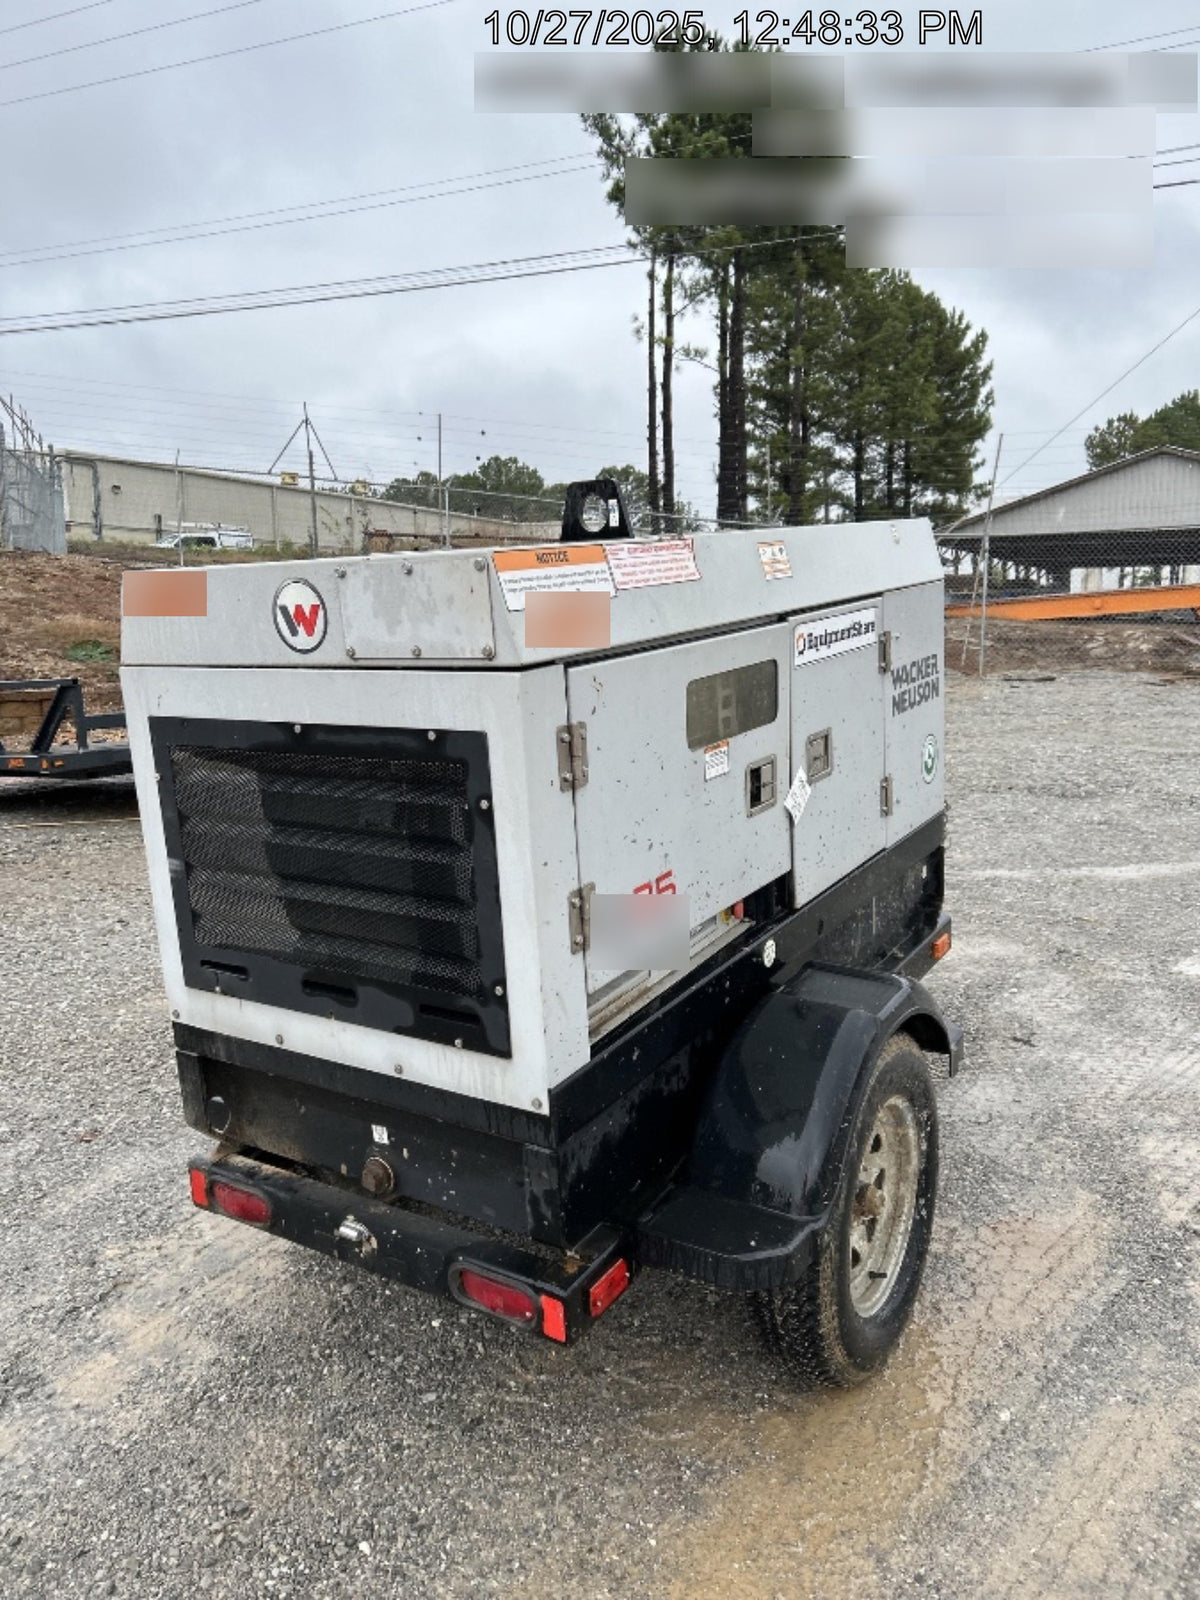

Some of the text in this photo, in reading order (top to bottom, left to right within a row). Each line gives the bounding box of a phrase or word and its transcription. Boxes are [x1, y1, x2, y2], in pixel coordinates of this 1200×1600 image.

[534, 550, 570, 564] NOTICE
[890, 653, 940, 690] WACKER
[892, 677, 940, 717] NEUSON
